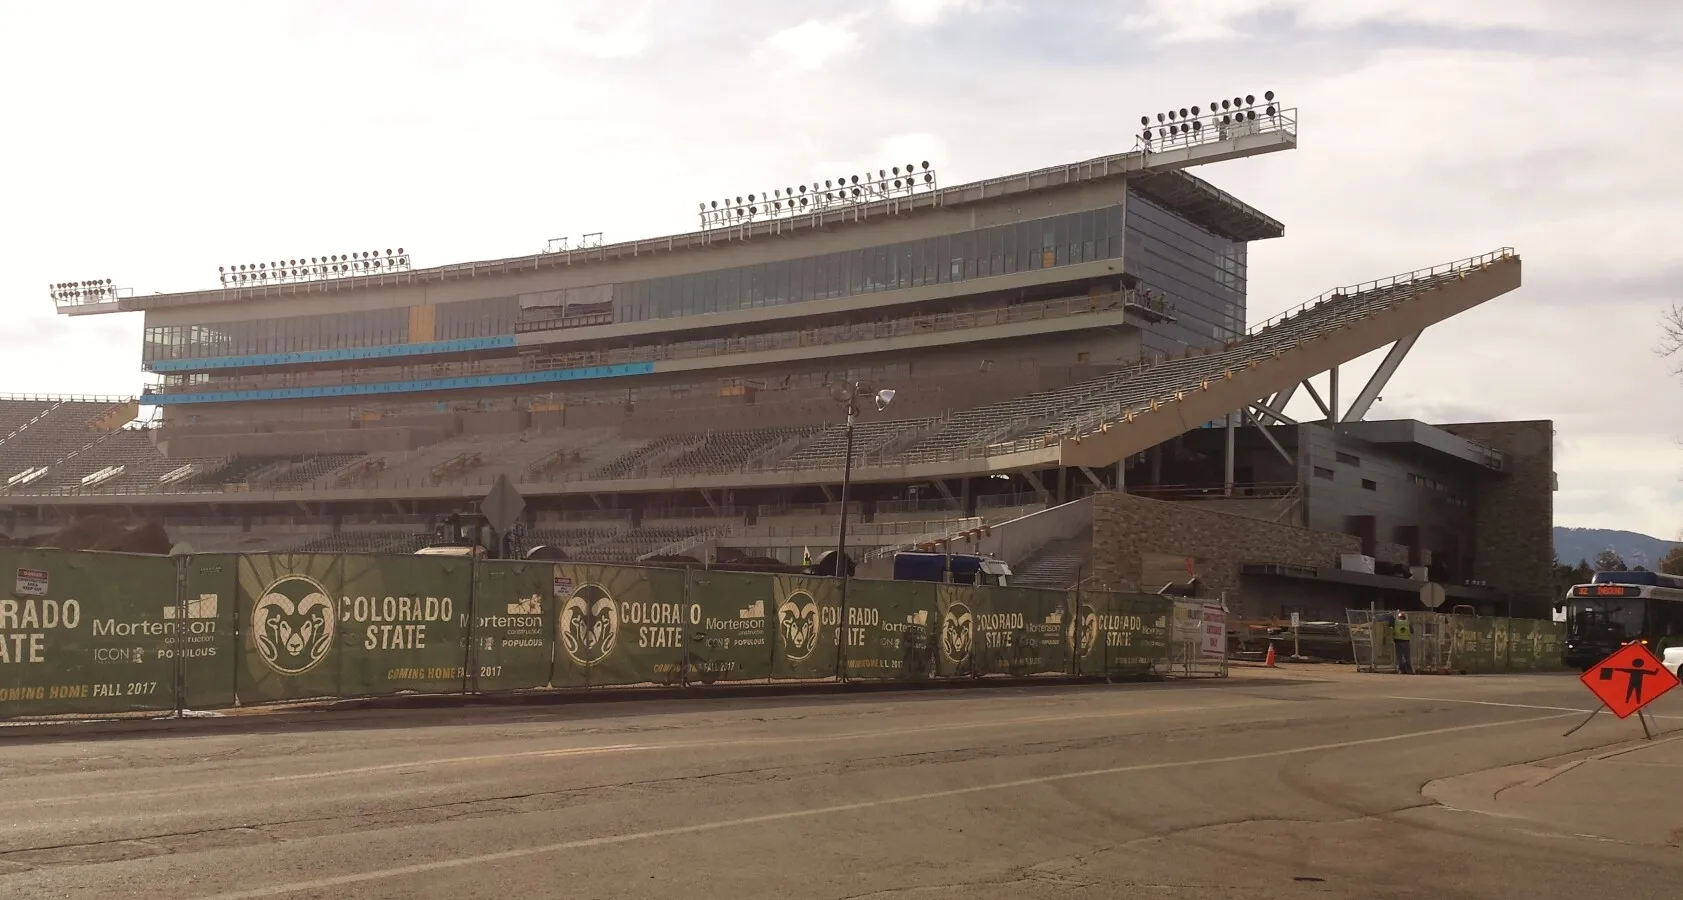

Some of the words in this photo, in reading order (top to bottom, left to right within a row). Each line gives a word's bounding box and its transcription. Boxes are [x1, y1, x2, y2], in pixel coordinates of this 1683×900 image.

[338, 596, 453, 622] COLORADO
[621, 602, 700, 625] COLORAO
[92, 619, 217, 636] Mortenon
[706, 618, 765, 630] Mortenson
[364, 624, 426, 650] STATE
[502, 639, 543, 647] POPULOUS
[638, 627, 682, 648] STATE
[734, 639, 765, 647] POPULOUS
[985, 632, 1013, 648] STATE
[94, 648, 130, 661] ICON
[387, 668, 425, 680] COMING
[427, 667, 456, 679] HOME
[480, 666, 502, 677] 2017
[49, 684, 89, 699] HOME
[93, 684, 122, 697] FALL
[127, 682, 157, 695] 2017
